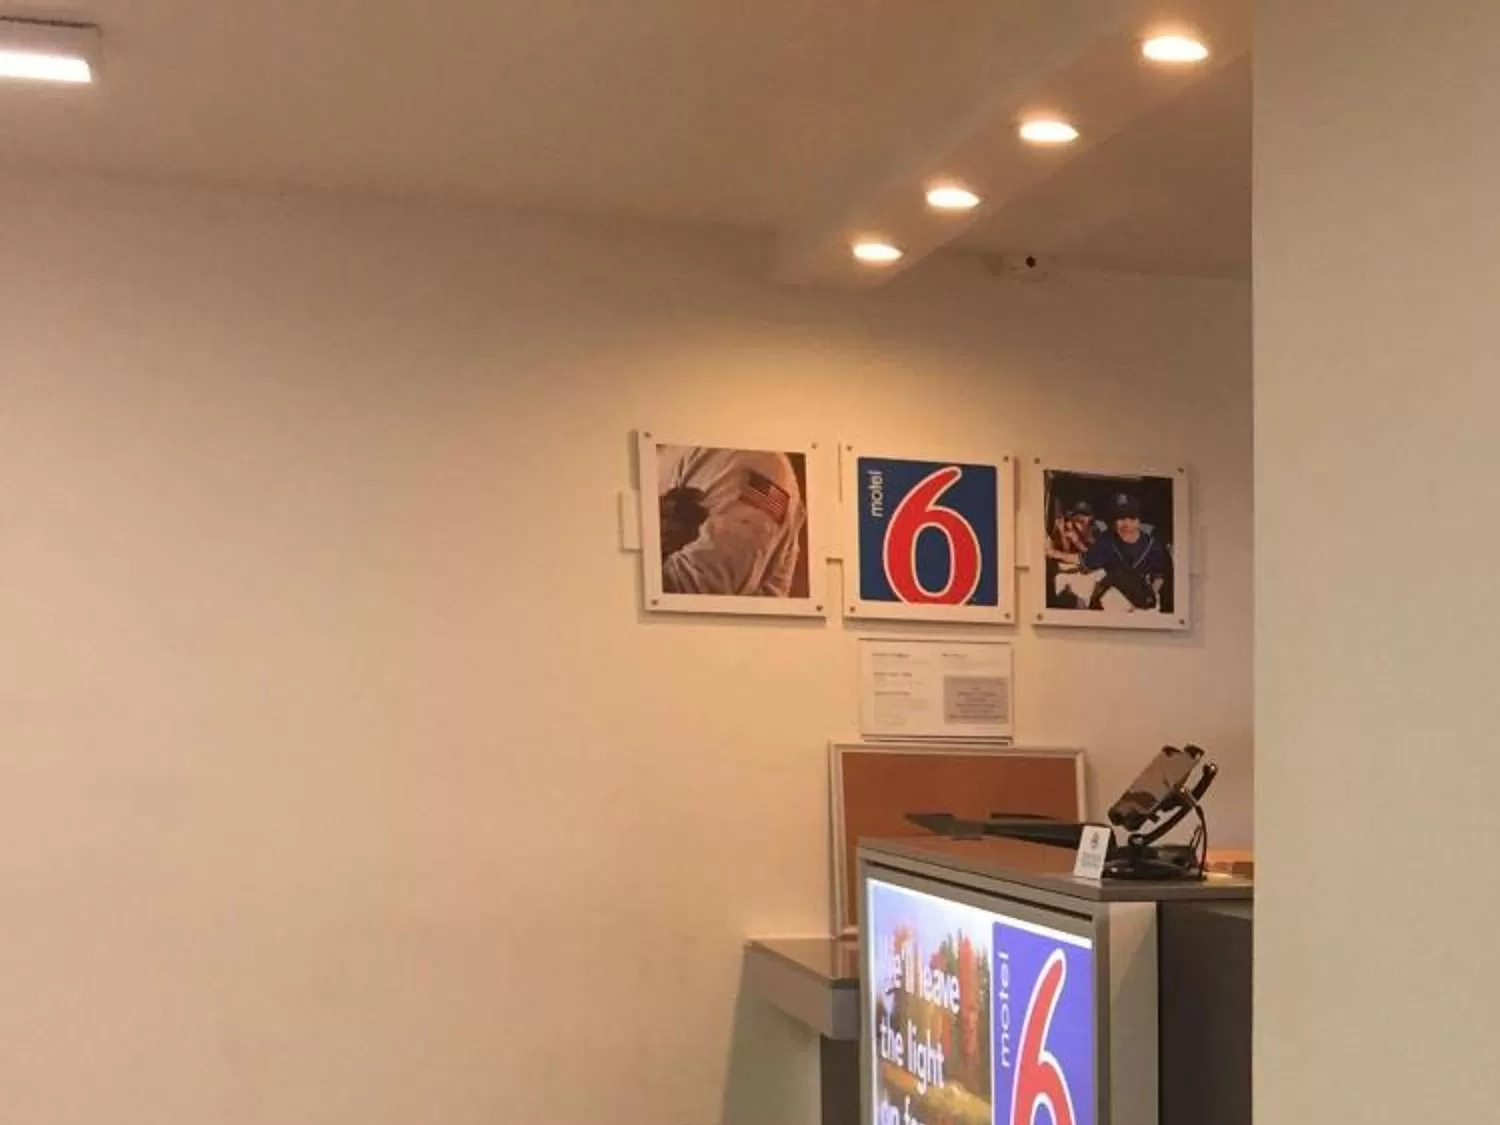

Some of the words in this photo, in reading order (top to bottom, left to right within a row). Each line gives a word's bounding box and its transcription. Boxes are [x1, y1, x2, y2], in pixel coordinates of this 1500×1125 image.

[868, 469, 883, 517] motel
[883, 466, 982, 606] 6
[917, 944, 961, 1014] leave
[1001, 950, 1011, 1069] motel
[880, 1016, 904, 1067] the
[907, 1018, 945, 1095] light
